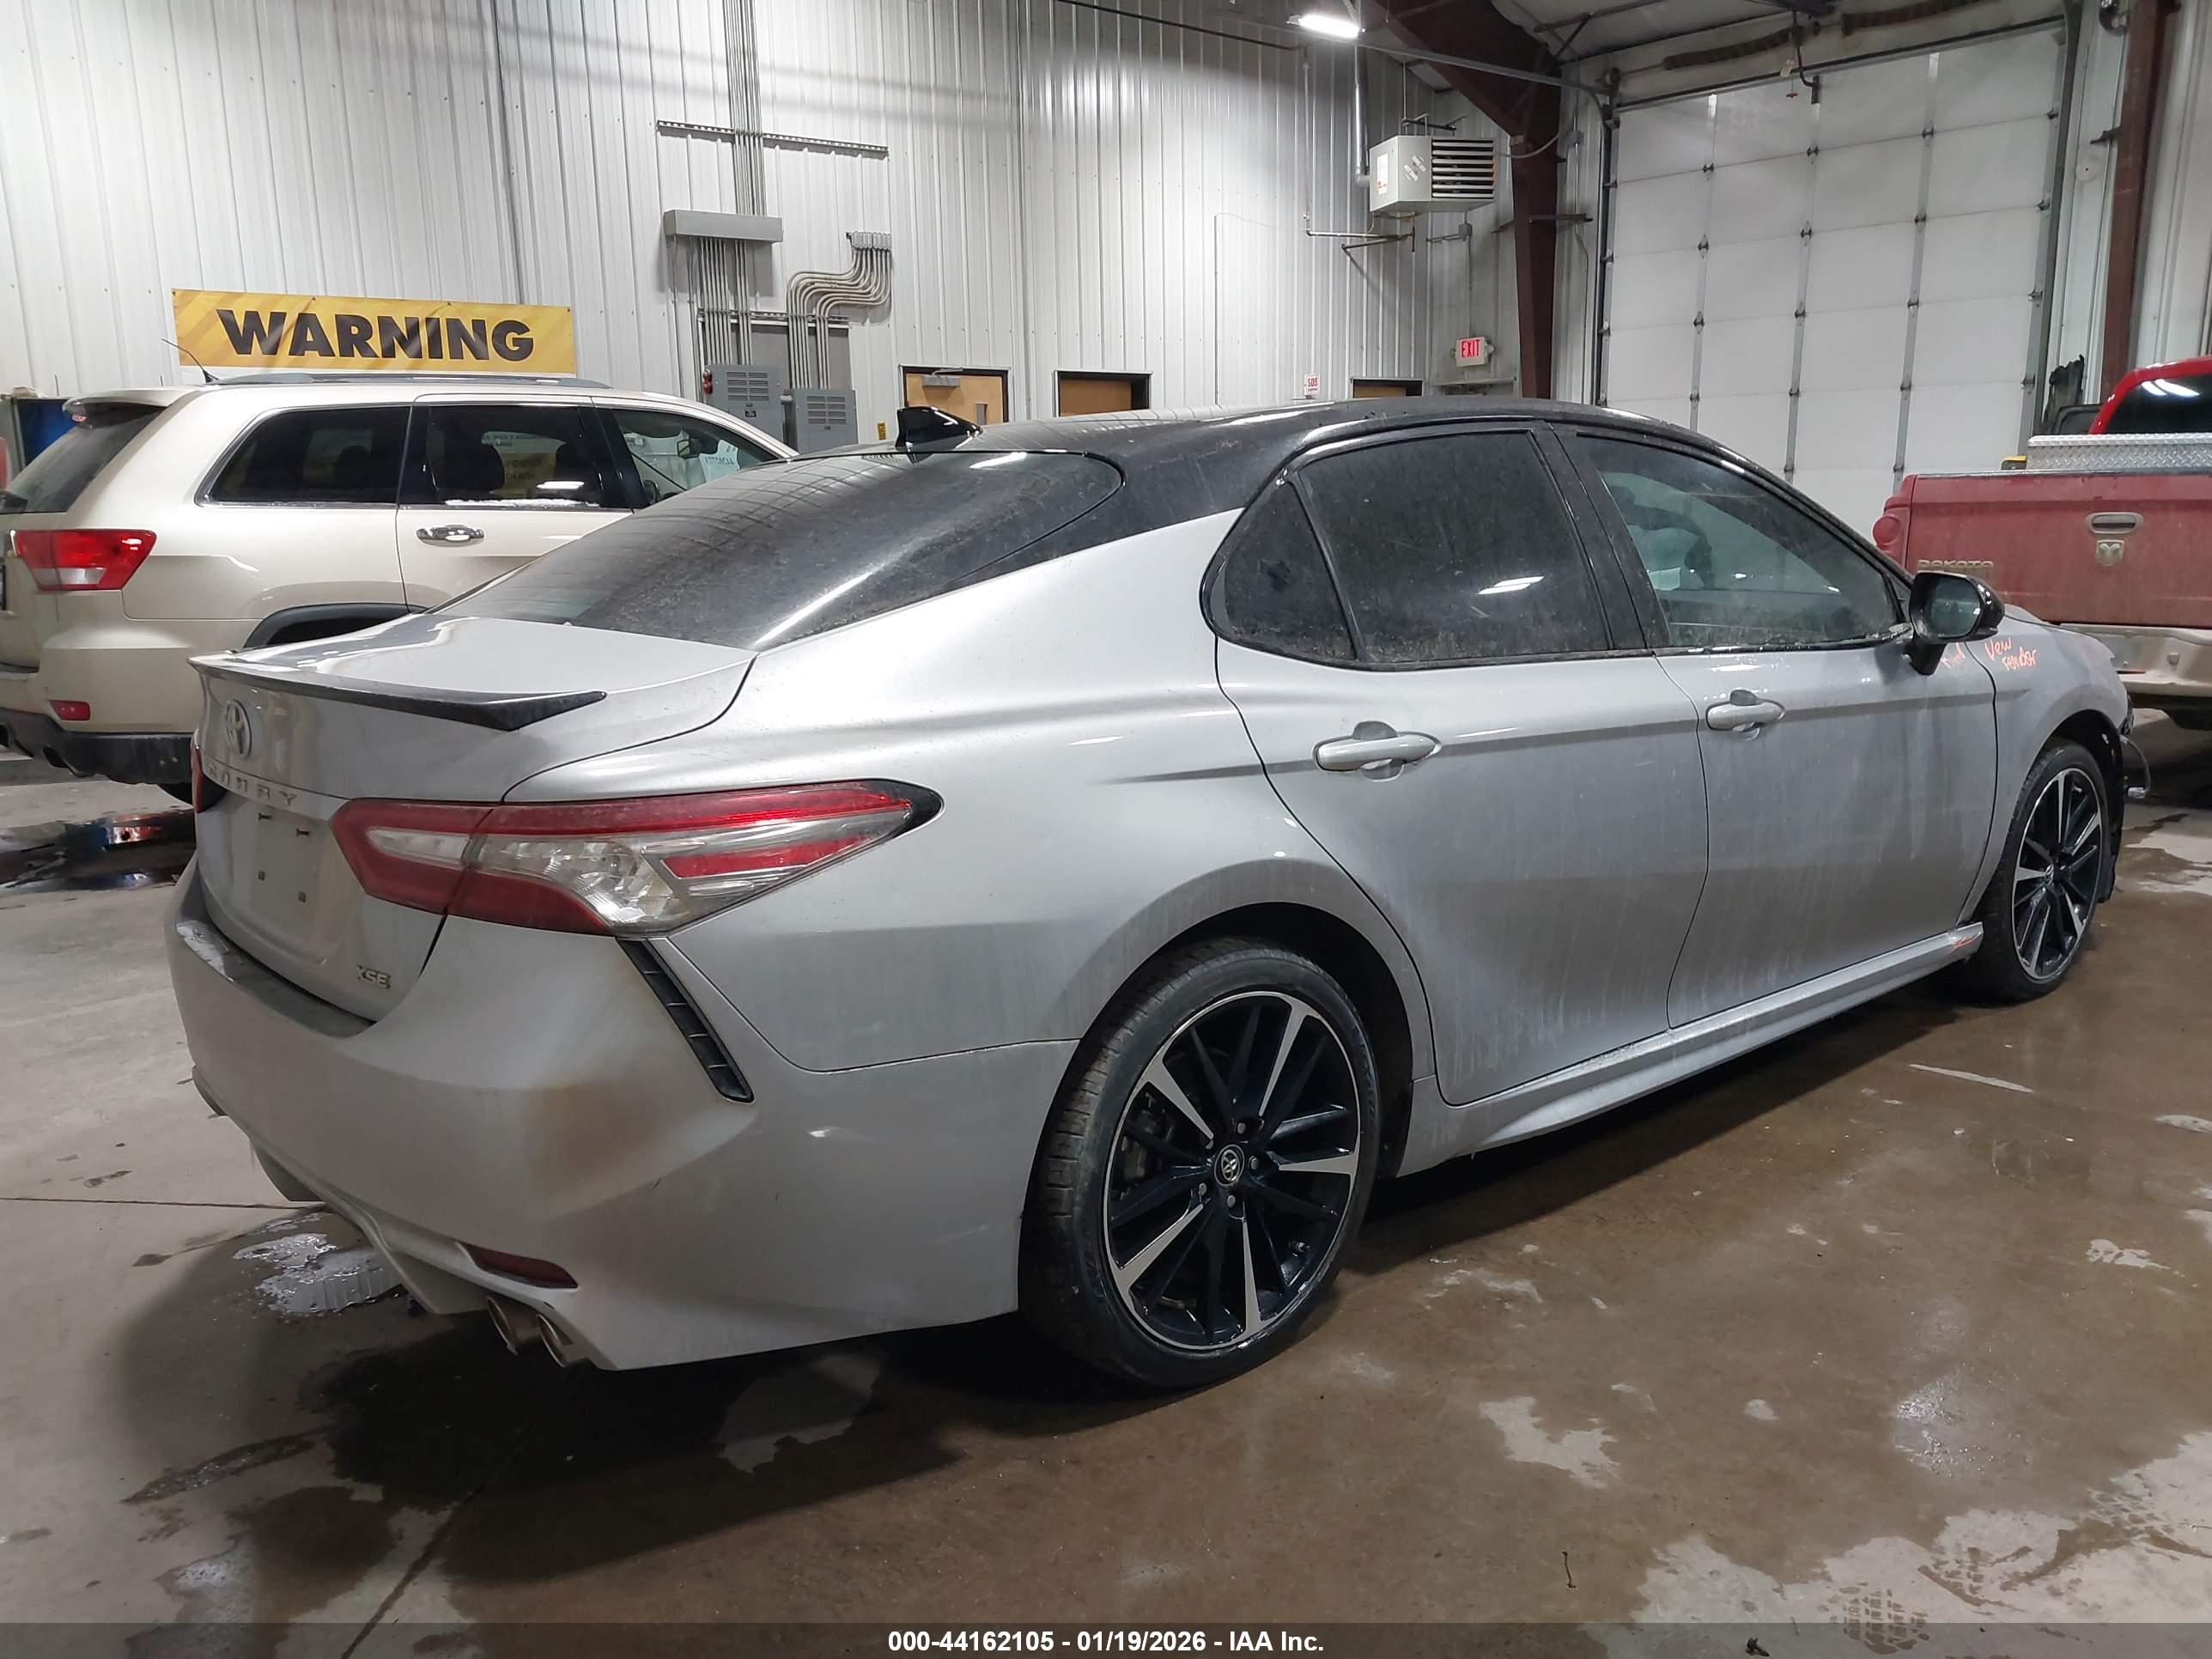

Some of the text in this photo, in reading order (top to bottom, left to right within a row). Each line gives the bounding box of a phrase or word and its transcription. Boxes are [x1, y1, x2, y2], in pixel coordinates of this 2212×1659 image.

[216, 308, 534, 362] WARNING
[1462, 339, 1480, 357] EXIT
[1307, 377, 1318, 387] SOS
